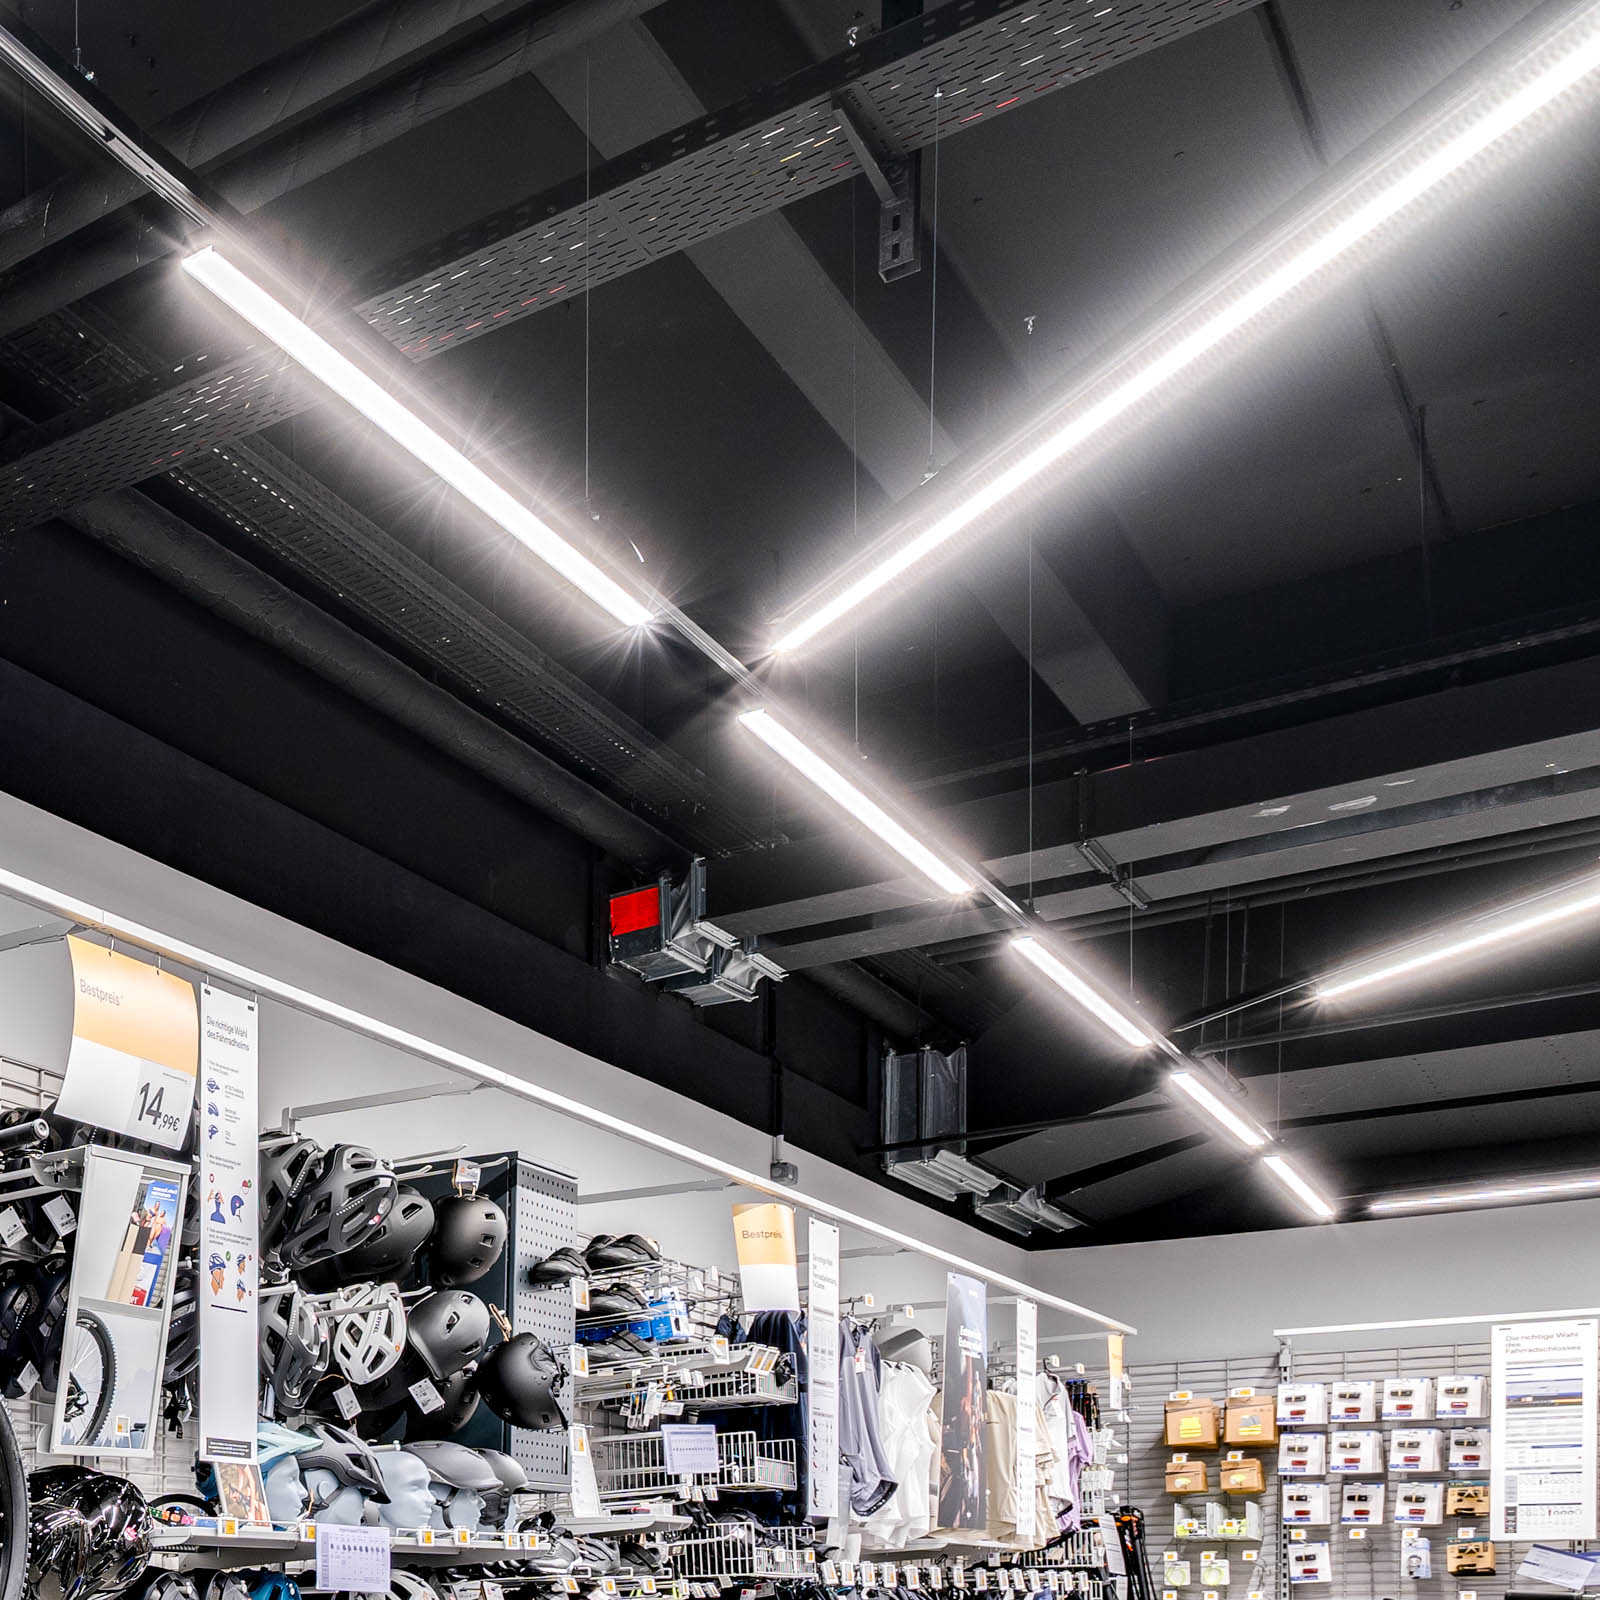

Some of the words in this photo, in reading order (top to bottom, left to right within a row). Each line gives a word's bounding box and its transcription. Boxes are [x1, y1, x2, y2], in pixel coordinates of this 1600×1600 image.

[206, 1015, 215, 1027] Die
[234, 1025, 248, 1039] Wahl
[137, 1081, 181, 1132] 14,99€
